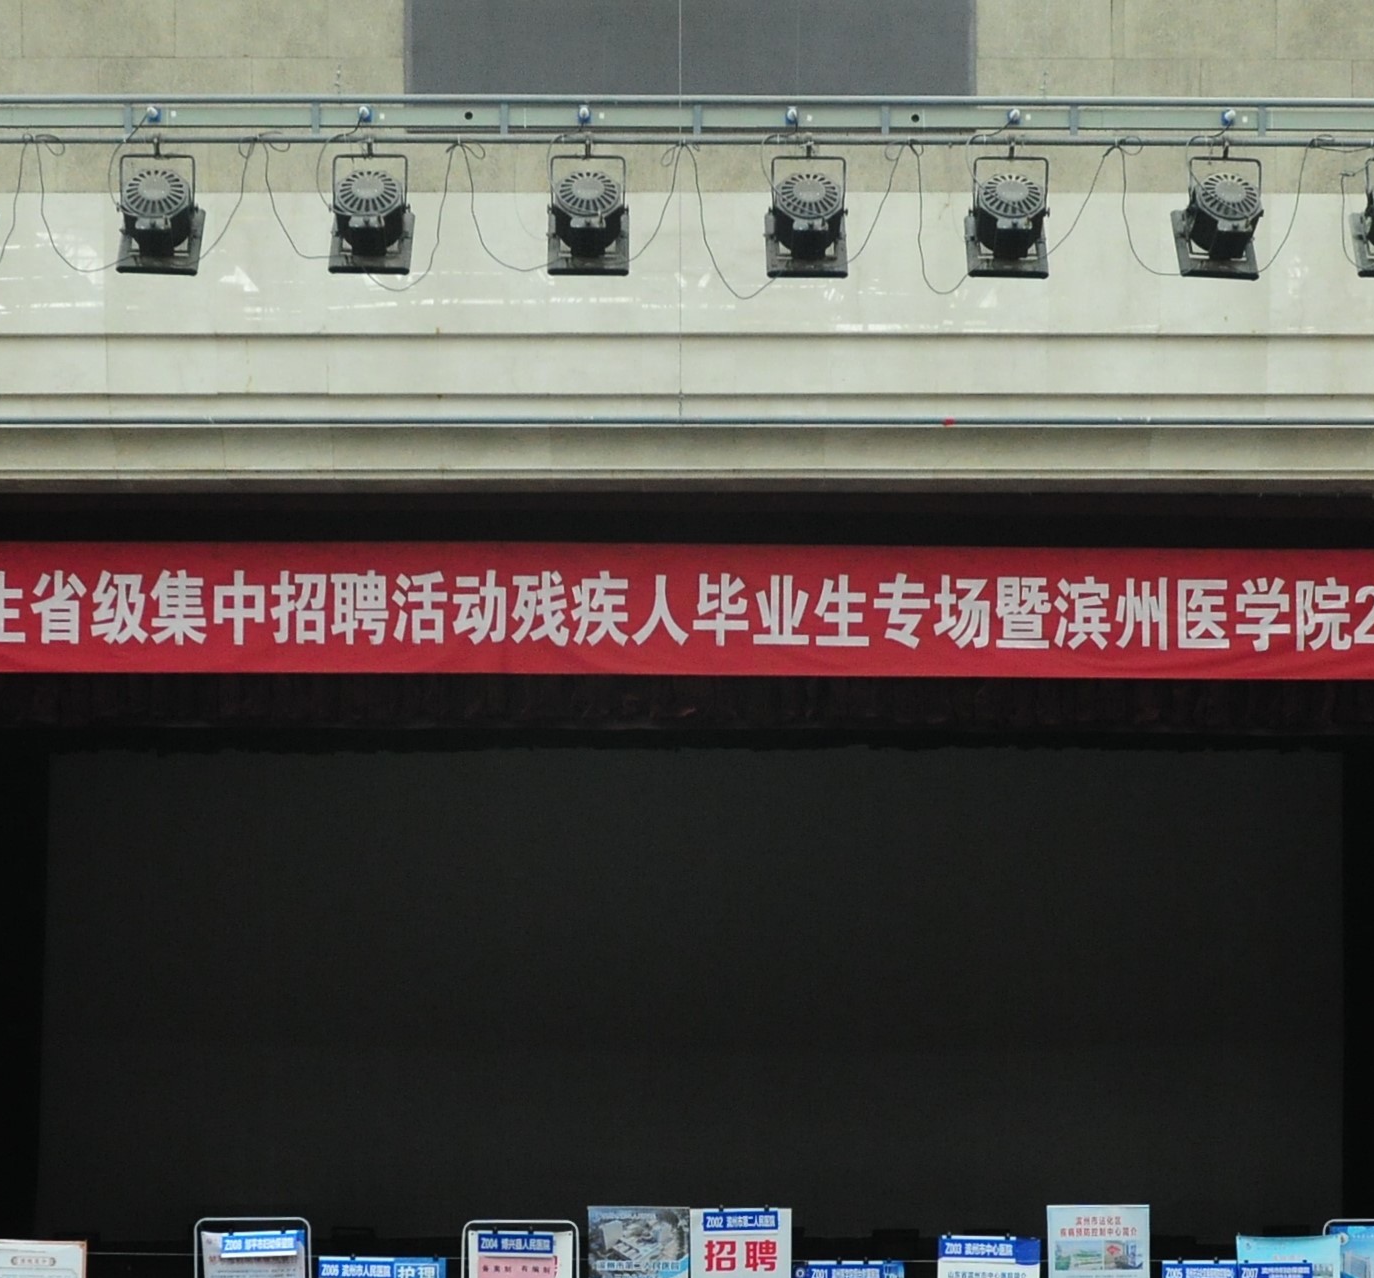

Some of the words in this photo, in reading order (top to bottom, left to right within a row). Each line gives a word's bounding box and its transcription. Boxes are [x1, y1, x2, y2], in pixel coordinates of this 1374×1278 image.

[706, 1217, 724, 1228] Z002
[726, 1215, 775, 1229] 滨州市第二人民医院
[1060, 1227, 1137, 1238] 疾病预防控制中心简介
[480, 1236, 499, 1251] Z004
[704, 1240, 778, 1273] 招聘
[965, 1244, 1014, 1258] 滨州市中心医院
[341, 1264, 391, 1278] 滨州市人民医院
